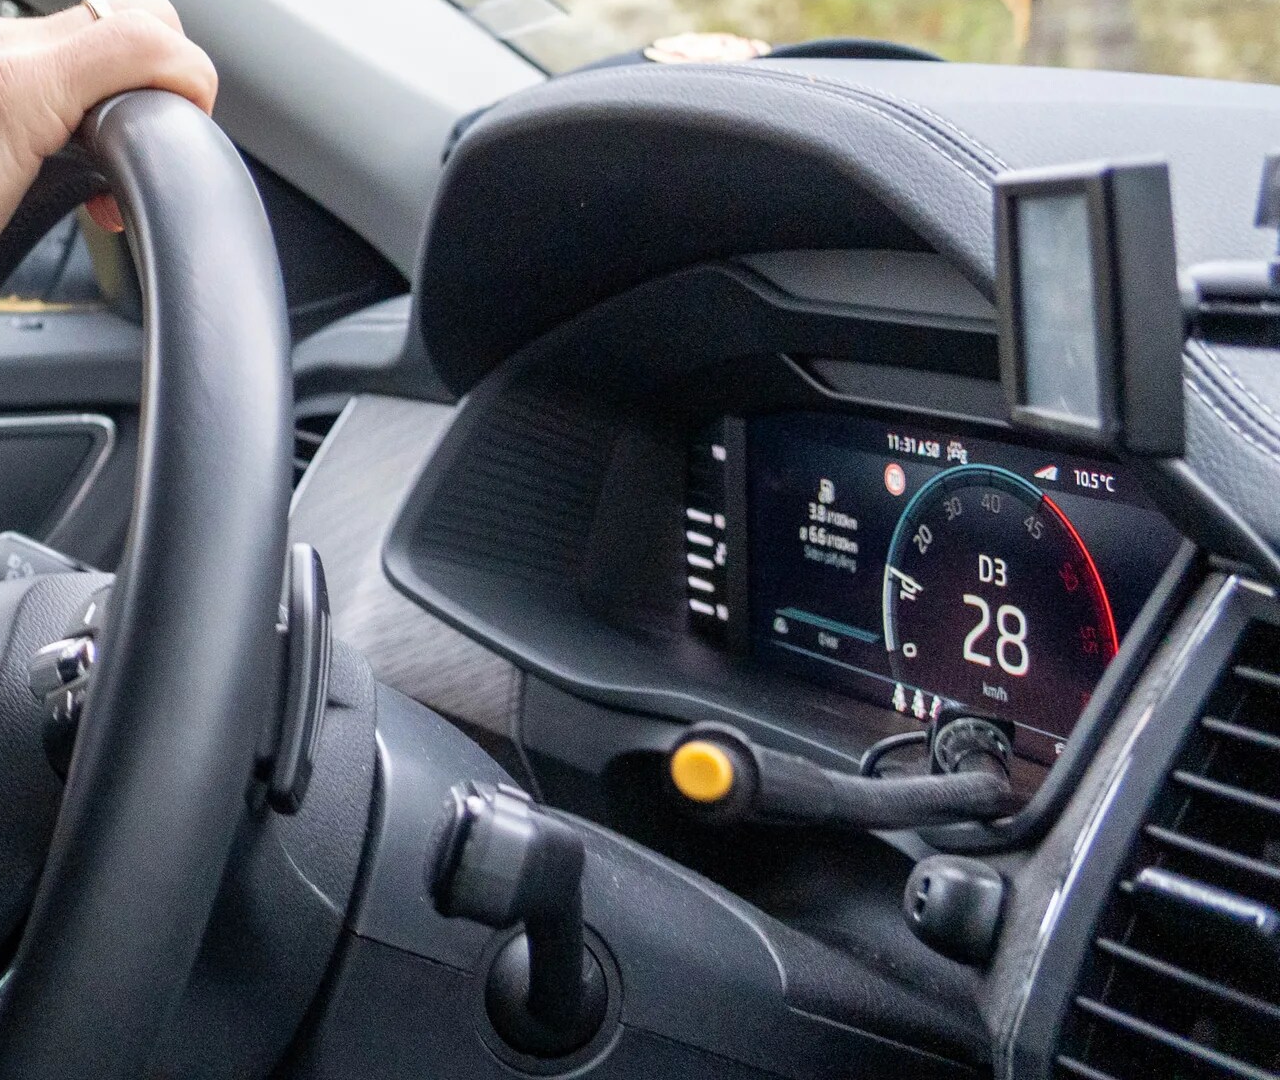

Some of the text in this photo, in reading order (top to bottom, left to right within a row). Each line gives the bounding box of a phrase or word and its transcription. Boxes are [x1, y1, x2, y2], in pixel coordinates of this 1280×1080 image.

[886, 433, 917, 454] 11:31
[1073, 469, 1116, 493] 10.5°C
[942, 496, 963, 521] 30
[981, 493, 1001, 514] 40
[913, 523, 934, 555] 20
[1023, 516, 1045, 540] 45
[978, 554, 1007, 587] D3
[962, 593, 1030, 677] 28
[902, 641, 918, 659] 0
[982, 681, 1008, 703] km/h
